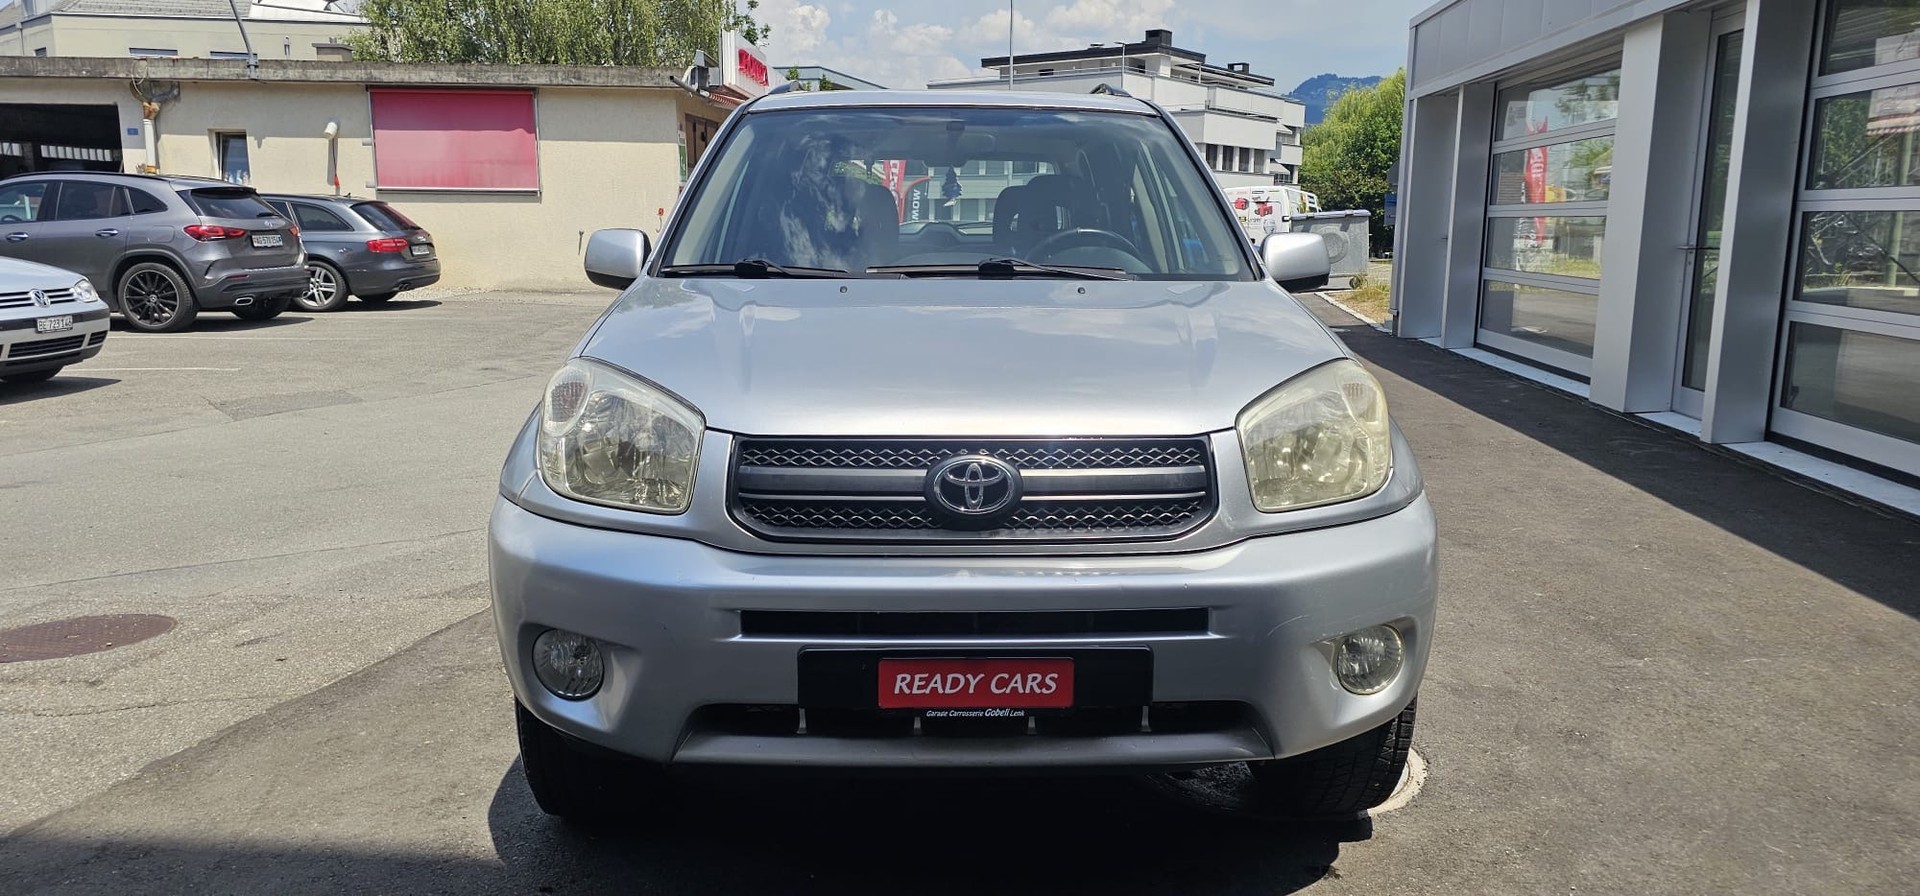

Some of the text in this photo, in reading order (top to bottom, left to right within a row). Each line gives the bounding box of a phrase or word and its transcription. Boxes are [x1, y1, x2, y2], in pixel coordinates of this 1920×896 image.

[894, 673, 1058, 695] READY CARS
[949, 709, 984, 717] Carrosserie
[1010, 709, 1025, 717] Lenk
